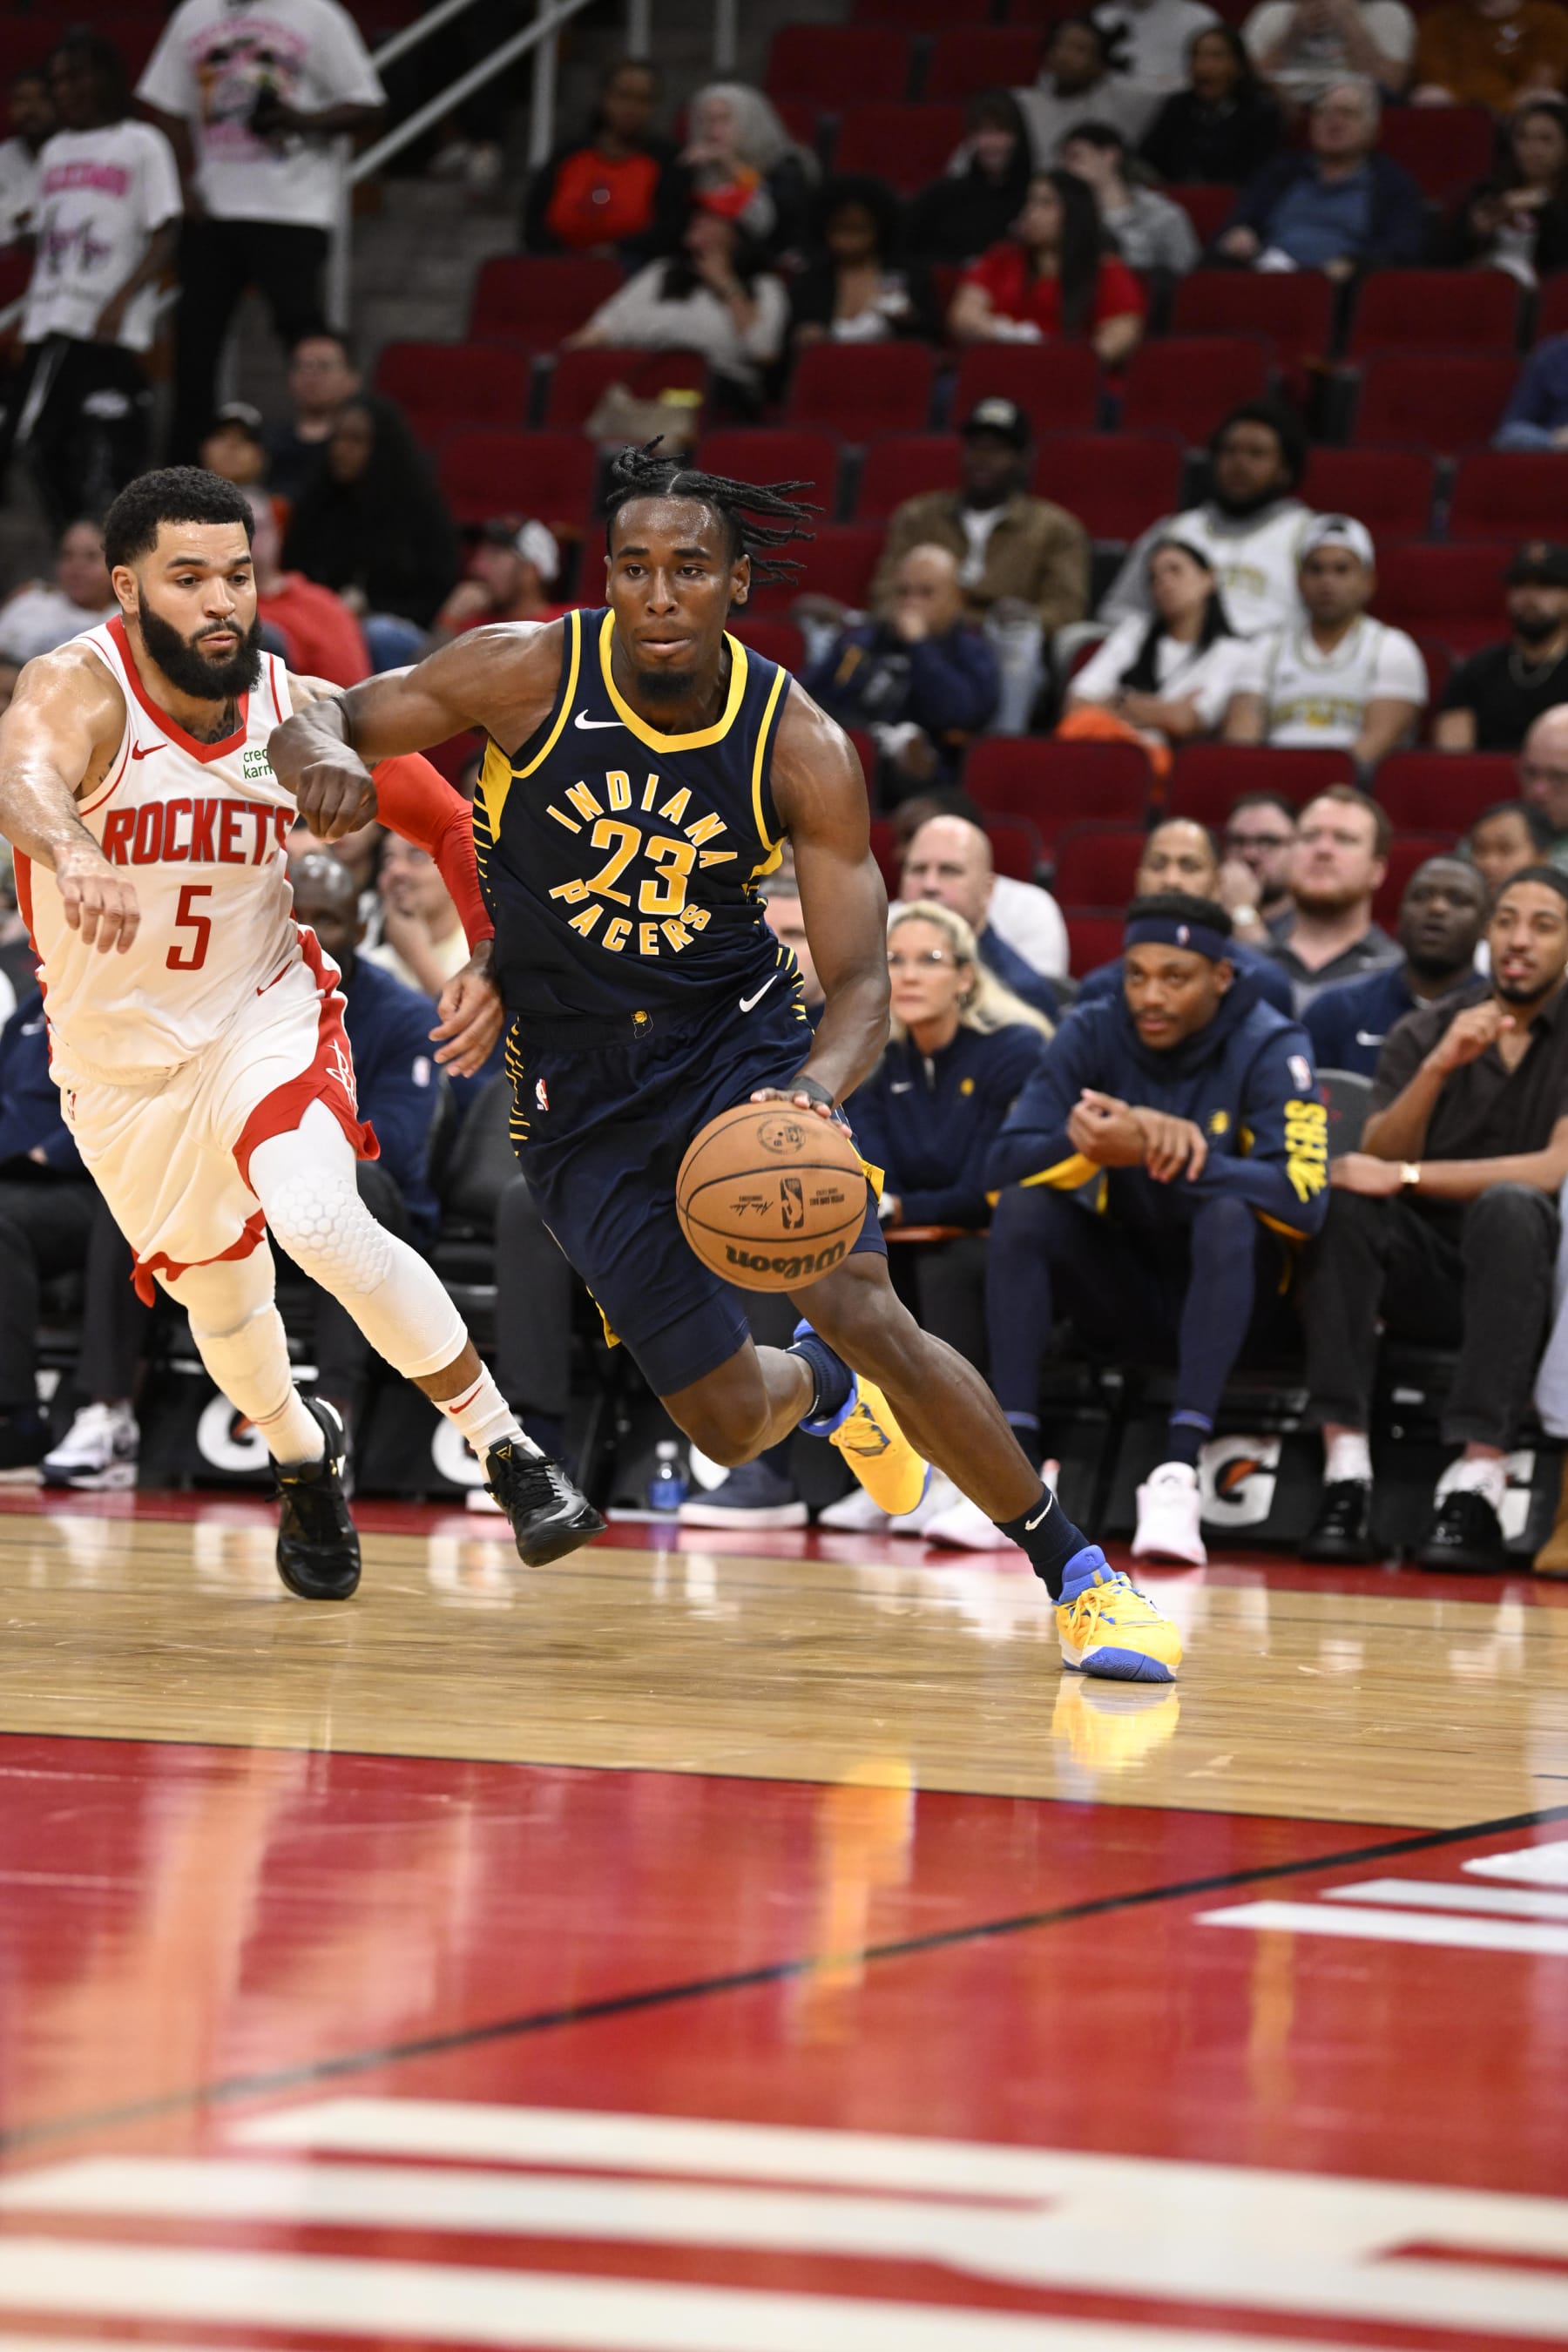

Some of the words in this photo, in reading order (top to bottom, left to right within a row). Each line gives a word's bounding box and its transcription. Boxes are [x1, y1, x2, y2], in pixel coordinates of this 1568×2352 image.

[102, 797, 295, 866] ROCKETS
[545, 770, 738, 868] INDIANA
[585, 818, 697, 916] 23
[166, 885, 213, 970] 5
[549, 878, 712, 956] PACERS
[726, 1240, 846, 1280] Wilson
